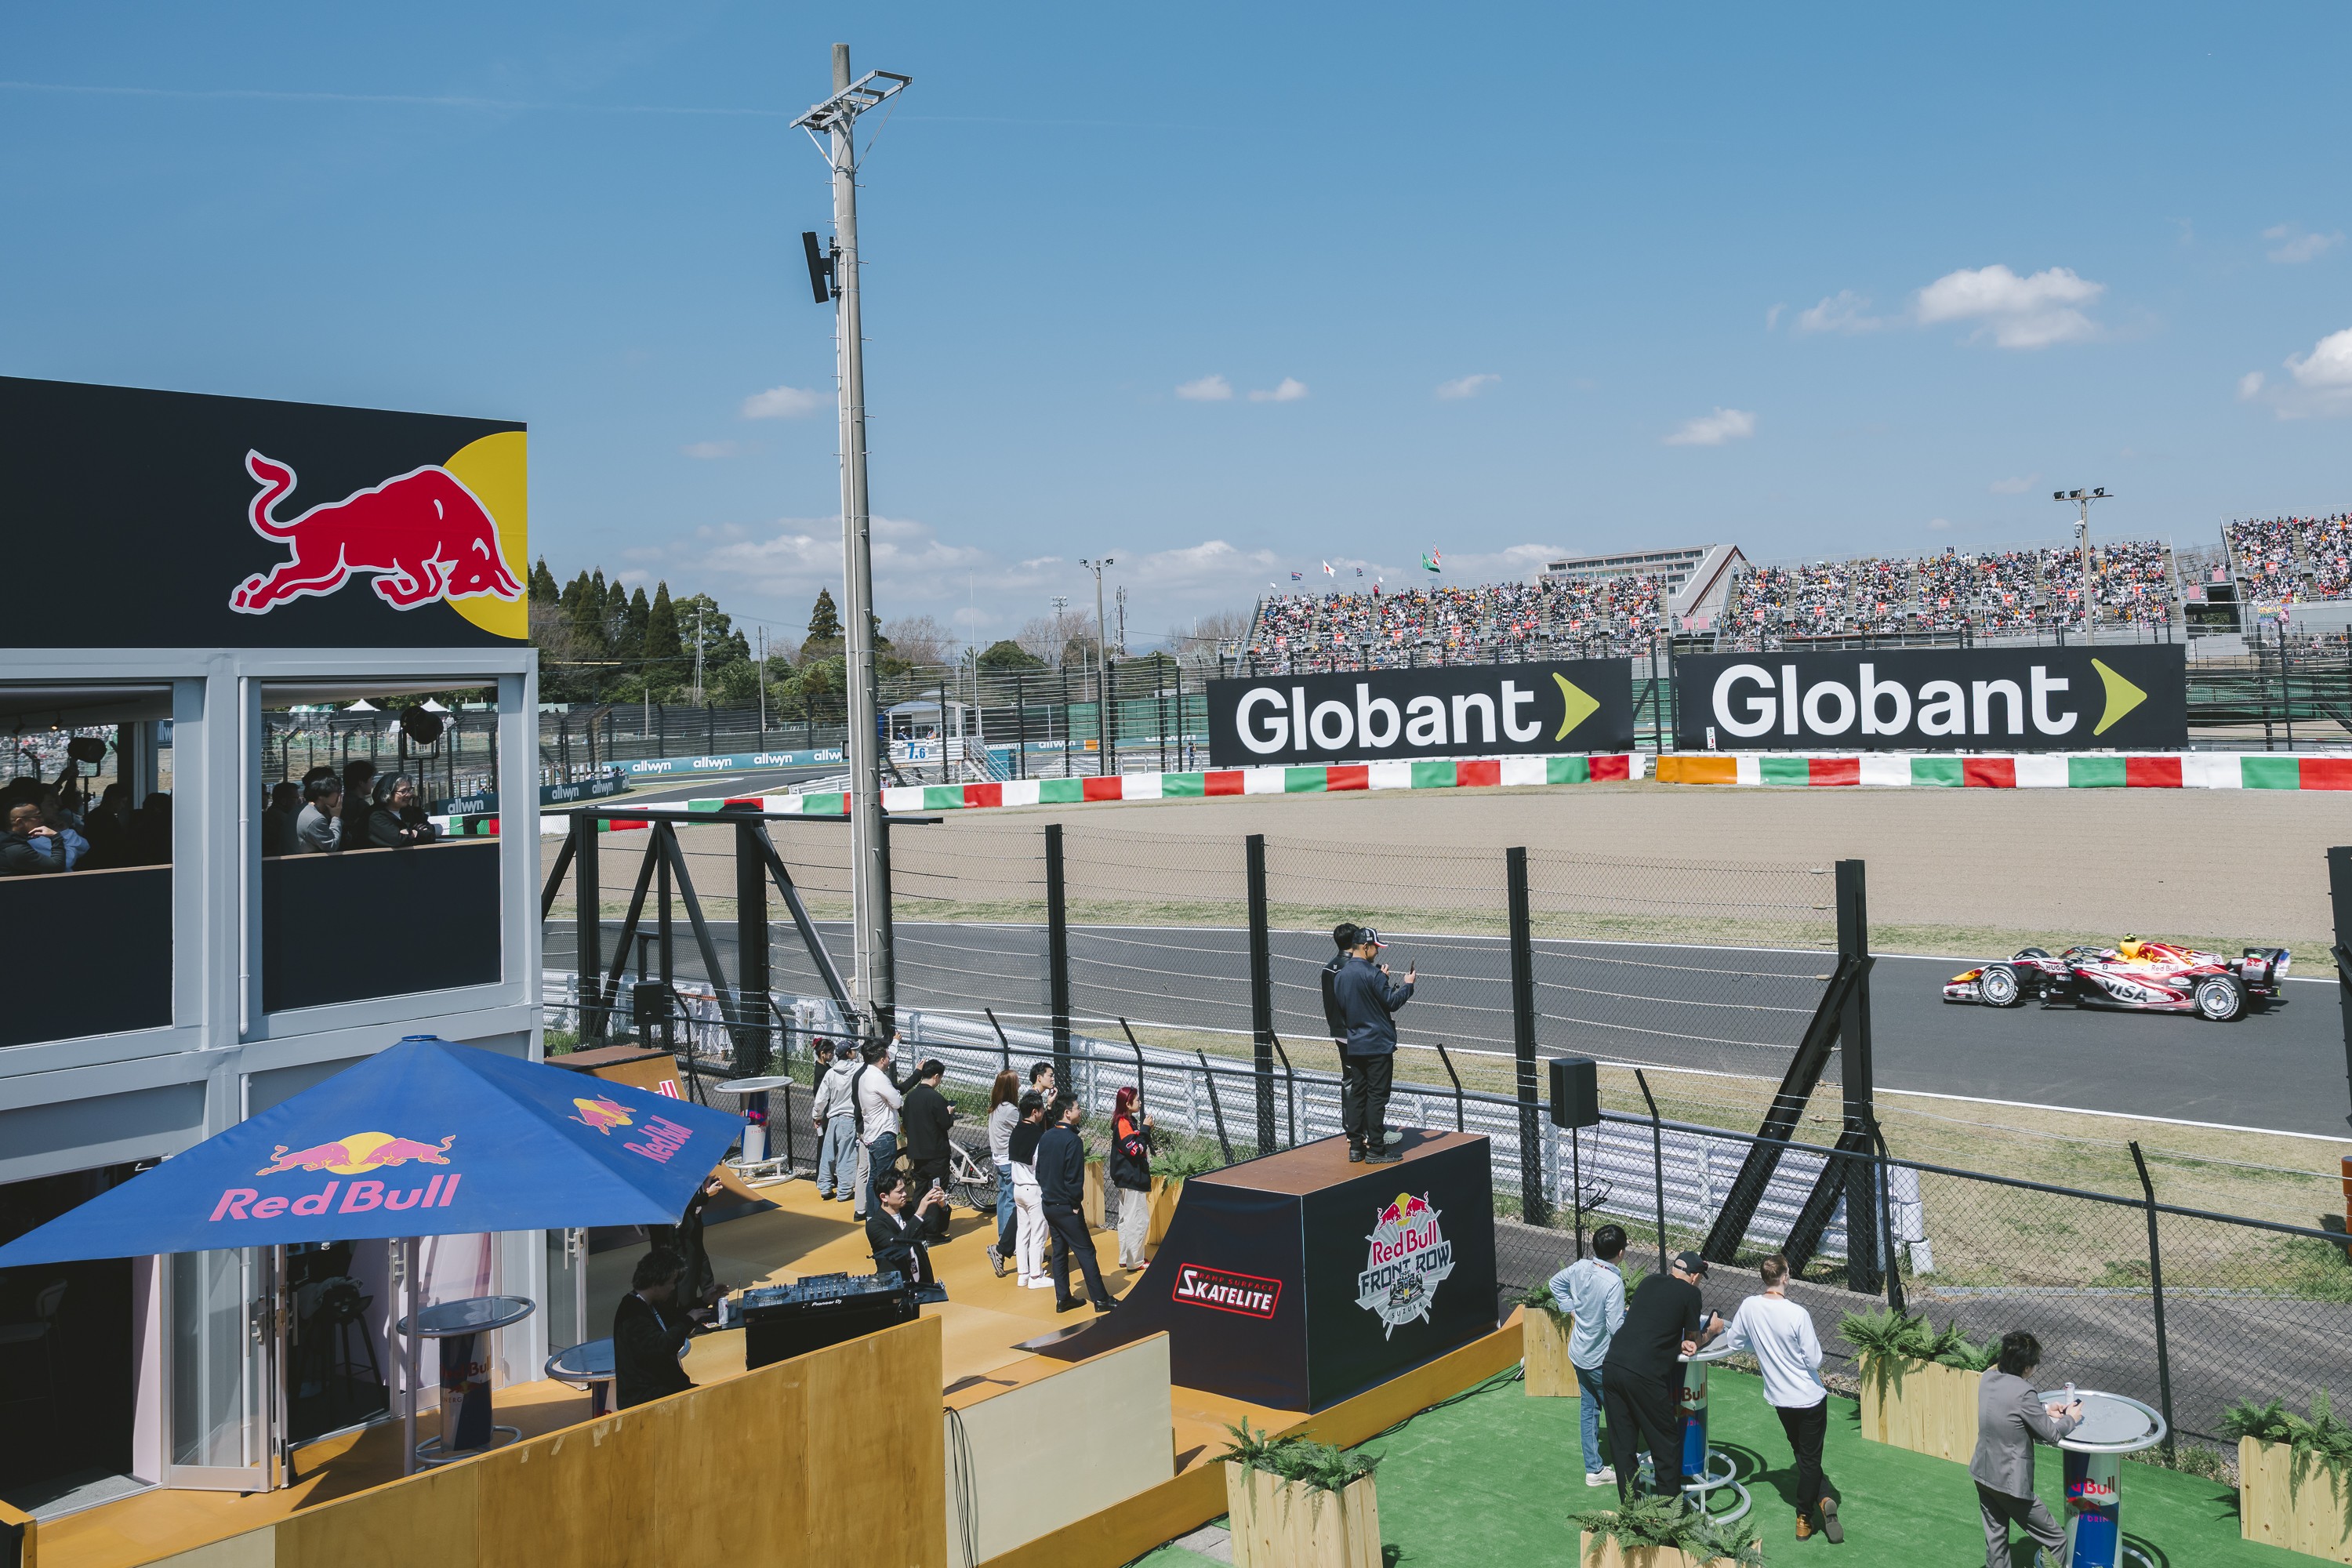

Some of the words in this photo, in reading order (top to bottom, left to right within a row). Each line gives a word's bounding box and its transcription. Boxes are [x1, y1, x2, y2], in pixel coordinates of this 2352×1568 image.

[1711, 663, 2078, 738] Globant
[1236, 680, 1542, 754] Globant
[753, 753, 793, 766] allwyn
[907, 742, 926, 759] 7.6
[632, 760, 672, 774] allwyn
[693, 757, 732, 770] allwyn
[552, 785, 579, 801] allwyn
[592, 780, 614, 796] allwyn
[448, 798, 485, 815] allwyn
[2104, 981, 2147, 1003] VISA
[644, 1114, 694, 1145] Bull
[623, 1128, 681, 1163] Red
[209, 1181, 339, 1222] Red
[337, 1174, 463, 1215] Bull
[1374, 1231, 1404, 1266] Red
[1406, 1220, 1437, 1254] Bull
[1361, 1258, 1411, 1297] FRONT
[1415, 1243, 1450, 1275] ROW
[1178, 1269, 1273, 1312] SKATELITE
[1200, 1272, 1225, 1283] RAMP
[1227, 1278, 1274, 1291] SURFACE
[1392, 1301, 1422, 1319] SUZUKA
[1680, 1381, 1706, 1402] Bull
[2083, 1475, 2115, 1495] Bull
